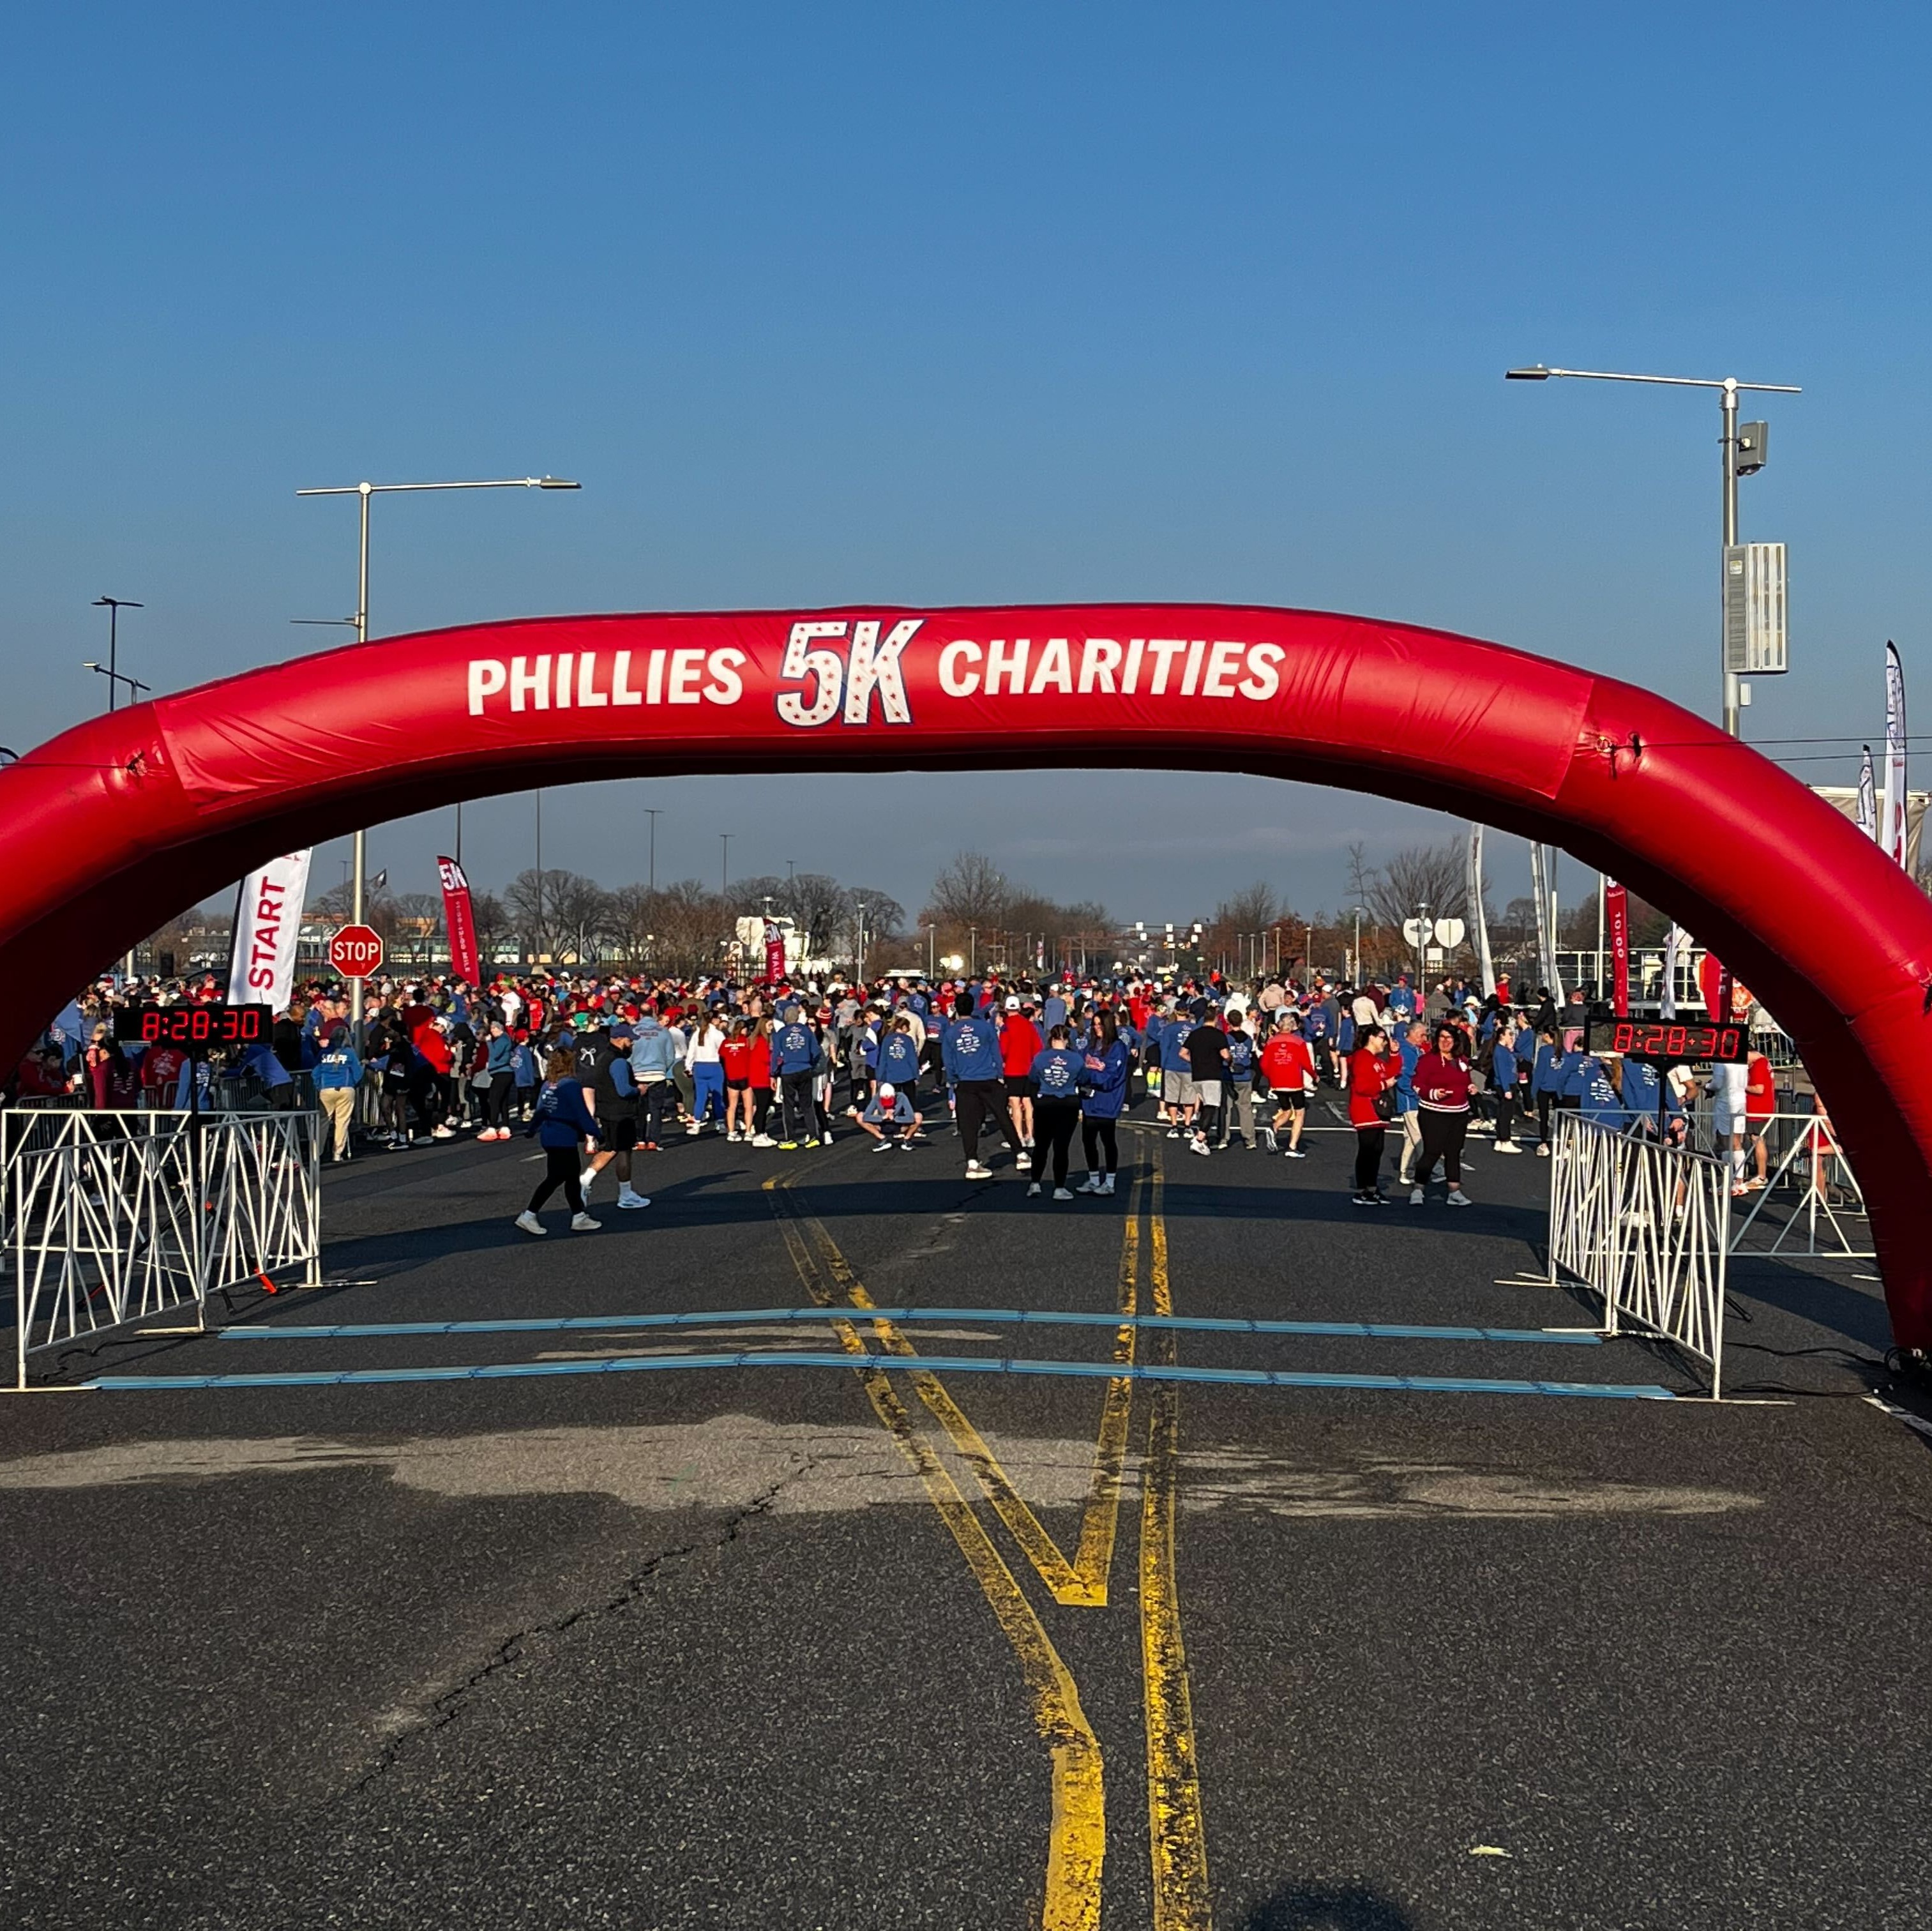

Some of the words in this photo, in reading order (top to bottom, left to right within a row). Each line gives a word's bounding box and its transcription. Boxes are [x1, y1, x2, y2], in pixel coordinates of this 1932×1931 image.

[468, 647, 746, 716] PHILLIES
[776, 619, 926, 727] 5K
[938, 638, 1286, 700] CHARITIES
[249, 875, 285, 990] START
[333, 941, 379, 962] STOP
